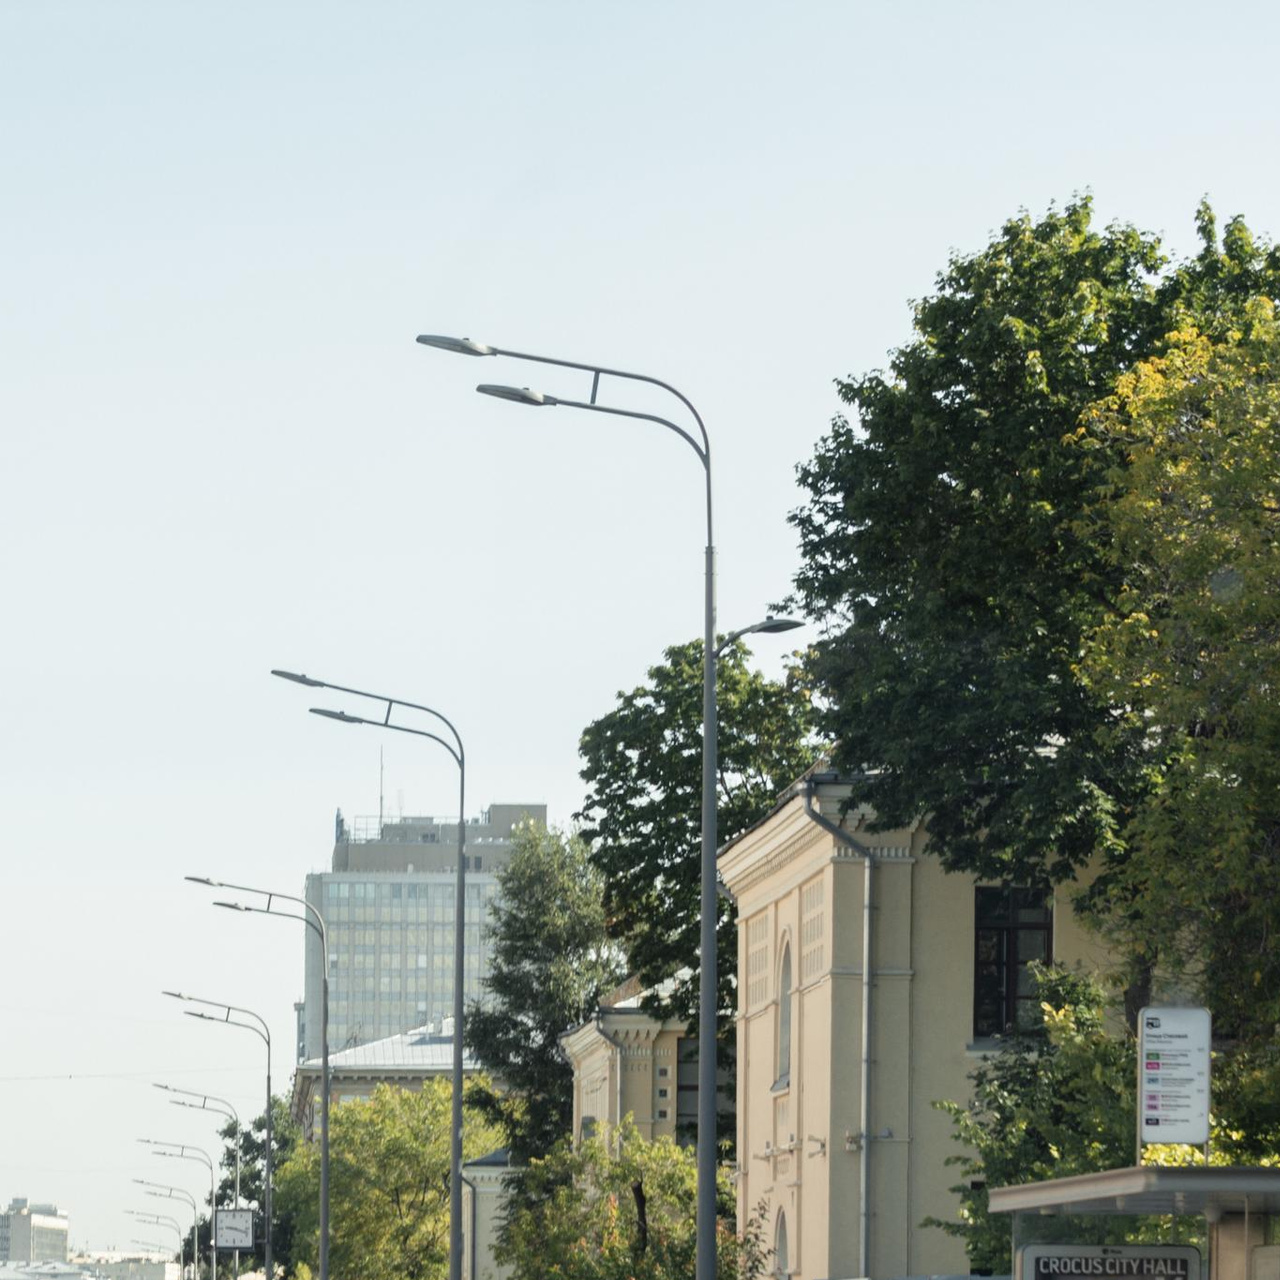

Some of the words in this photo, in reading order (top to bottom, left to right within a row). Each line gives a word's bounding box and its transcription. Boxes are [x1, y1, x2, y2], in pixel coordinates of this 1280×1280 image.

[1039, 1257, 1103, 1274] CROCUS
[1105, 1258, 1140, 1275] CITY
[1143, 1258, 1186, 1275] HALL
